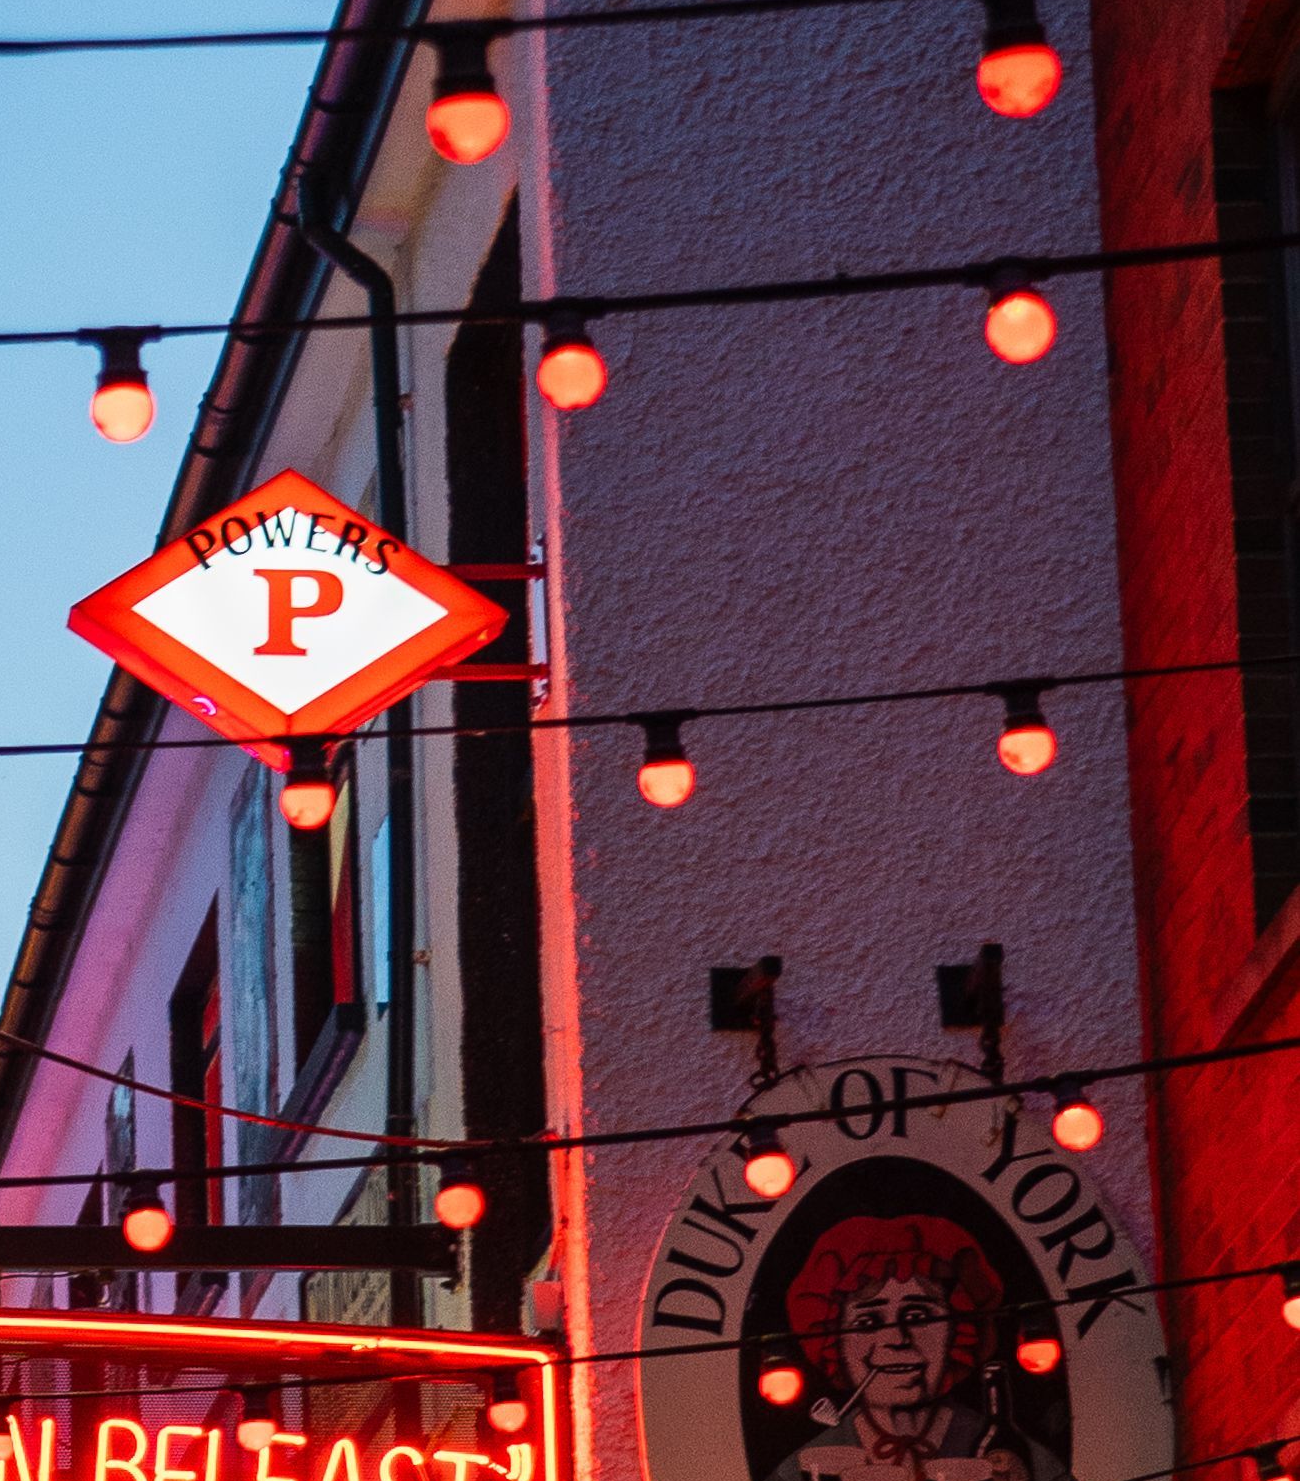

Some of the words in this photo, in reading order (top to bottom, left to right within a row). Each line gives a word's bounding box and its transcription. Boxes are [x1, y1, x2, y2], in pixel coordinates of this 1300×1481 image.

[185, 507, 399, 576] POWERS
[253, 568, 344, 656] P
[651, 1131, 813, 1337] DUKE
[829, 1066, 942, 1140] OF
[977, 1110, 1148, 1339] YORK
